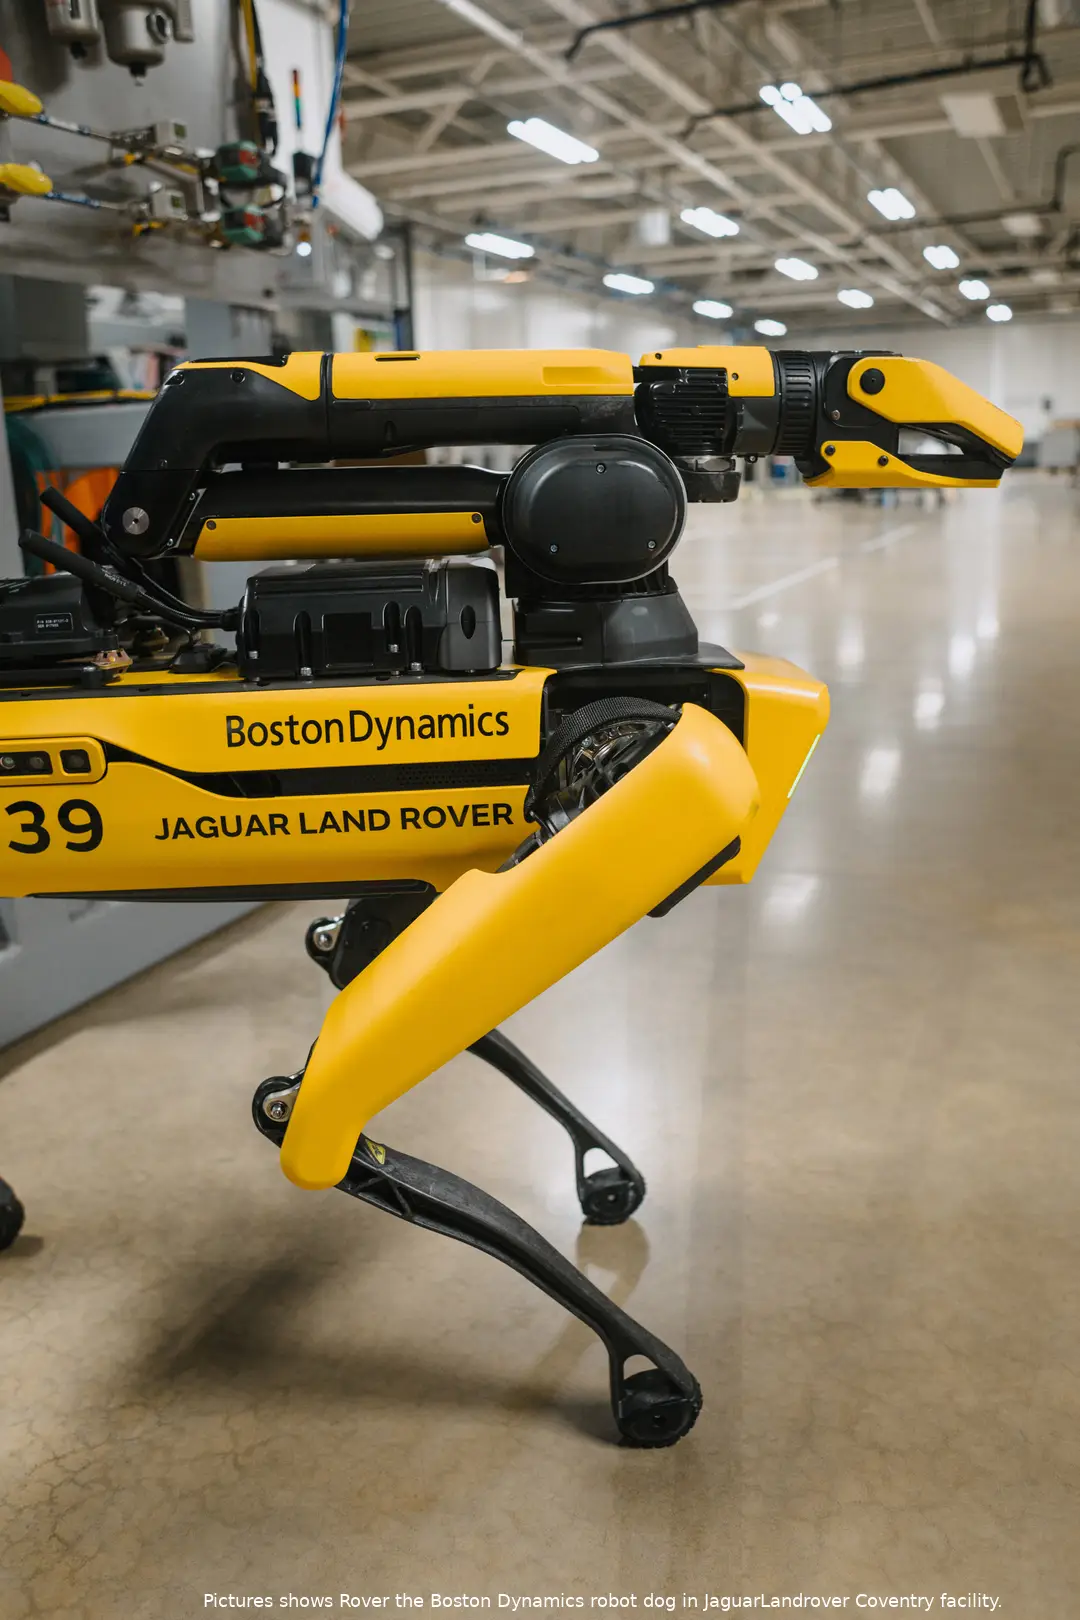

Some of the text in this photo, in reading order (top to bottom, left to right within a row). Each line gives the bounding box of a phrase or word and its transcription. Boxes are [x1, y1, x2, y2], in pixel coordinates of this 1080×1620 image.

[5, 799, 103, 854] 39
[155, 803, 514, 840] JAGUAR LAND ROVER
